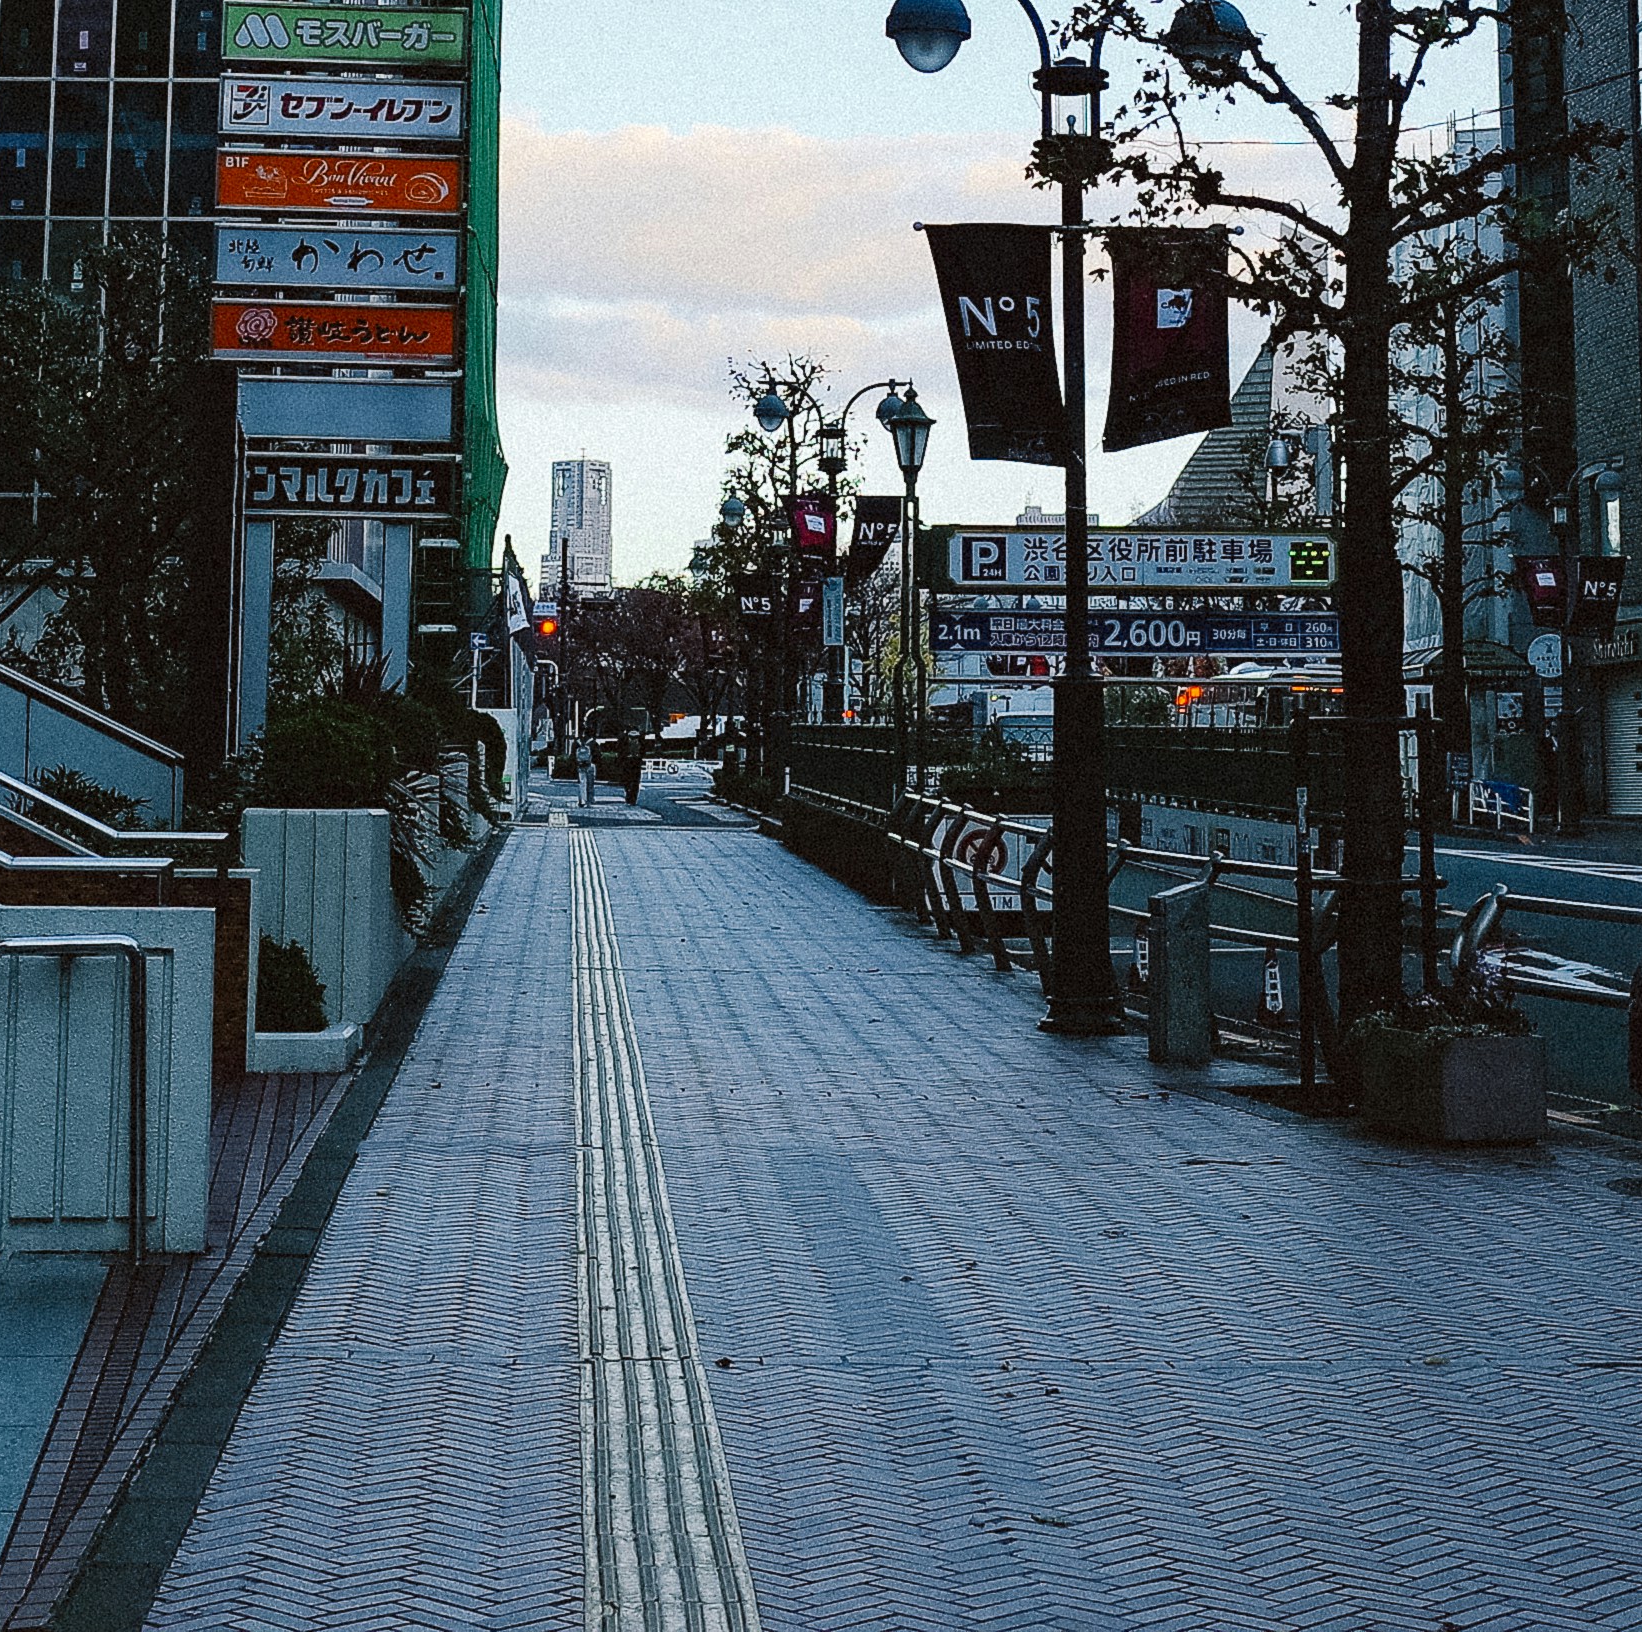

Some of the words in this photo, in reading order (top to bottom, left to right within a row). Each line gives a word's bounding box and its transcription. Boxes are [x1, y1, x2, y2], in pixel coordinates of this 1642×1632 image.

[295, 18, 455, 50] モスバーガー
[225, 156, 250, 169] B1F
[291, 158, 345, 187] Bon
[336, 160, 398, 188] Vivant
[291, 237, 437, 275] かわせ
[966, 340, 1013, 350] LIMITED
[971, 541, 999, 577] P
[982, 568, 1002, 577] 24H
[1583, 580, 1617, 597] N°5
[740, 596, 772, 611] N°5
[937, 623, 981, 640] 2.1m
[1104, 619, 1201, 648] 2,600円
